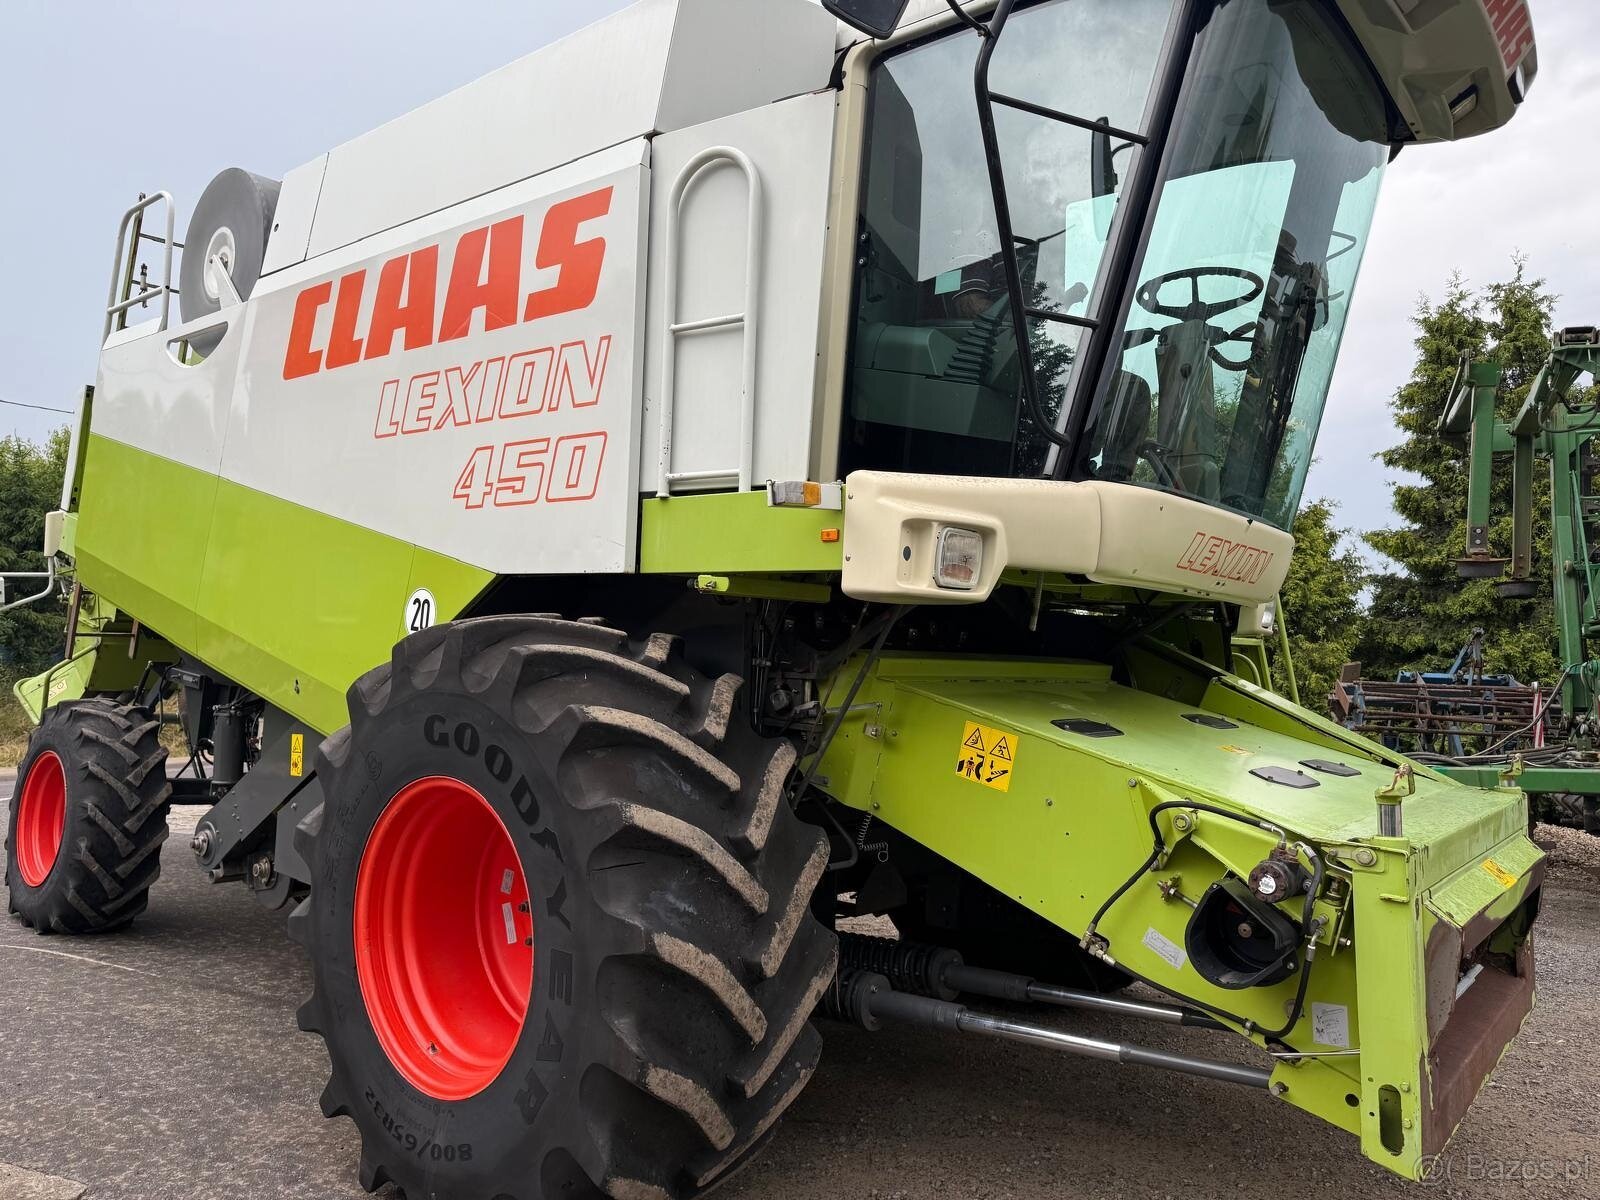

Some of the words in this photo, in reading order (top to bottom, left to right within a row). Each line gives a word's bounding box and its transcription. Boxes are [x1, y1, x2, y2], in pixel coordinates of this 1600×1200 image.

[282, 185, 615, 381] CLAAS
[373, 334, 613, 439] LEXION
[452, 431, 608, 510] 450
[1176, 531, 1274, 585] LEXION
[411, 597, 430, 631] 20
[423, 713, 574, 1126] GOODYEAR
[364, 1084, 473, 1161] 800/65R32
